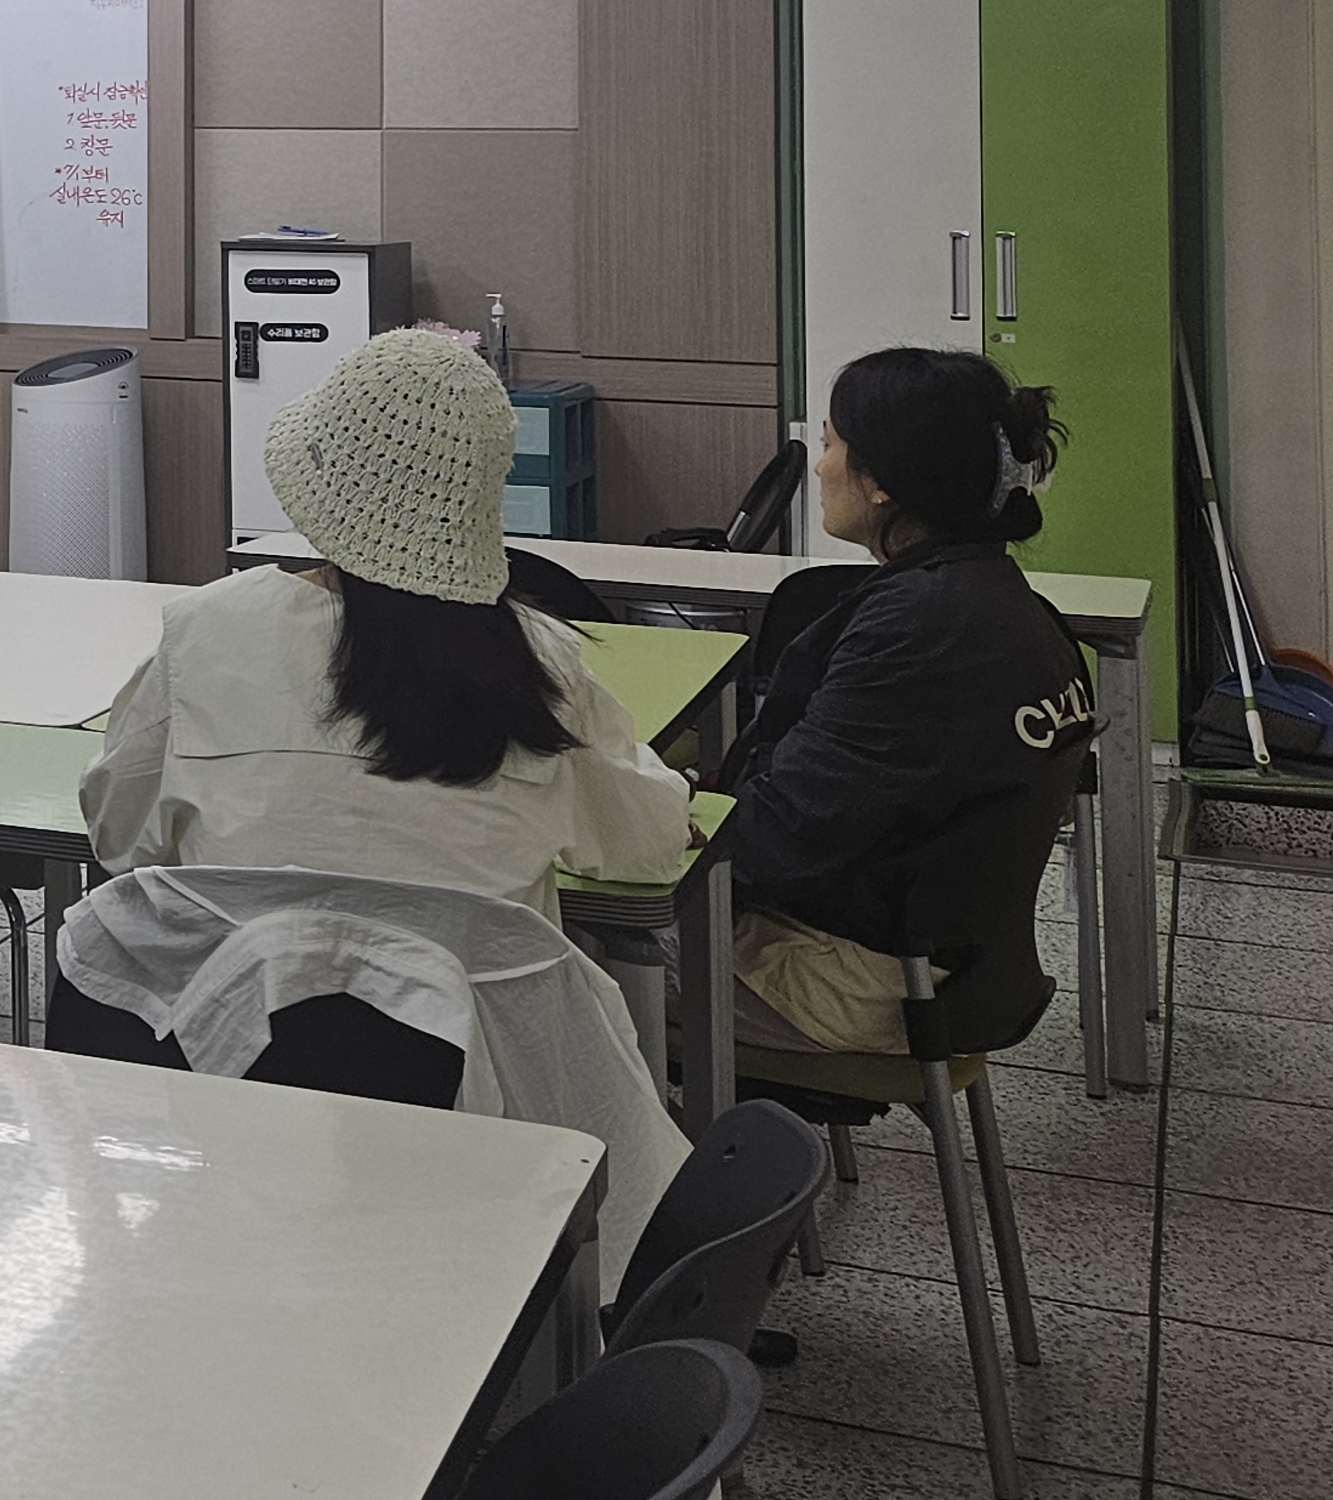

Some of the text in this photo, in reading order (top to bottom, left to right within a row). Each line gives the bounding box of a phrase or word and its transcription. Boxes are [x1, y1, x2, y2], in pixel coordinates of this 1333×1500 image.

[49, 182, 108, 207] 실내온도
[96, 209, 124, 228] 유지
[294, 327, 321, 338] 보관함
